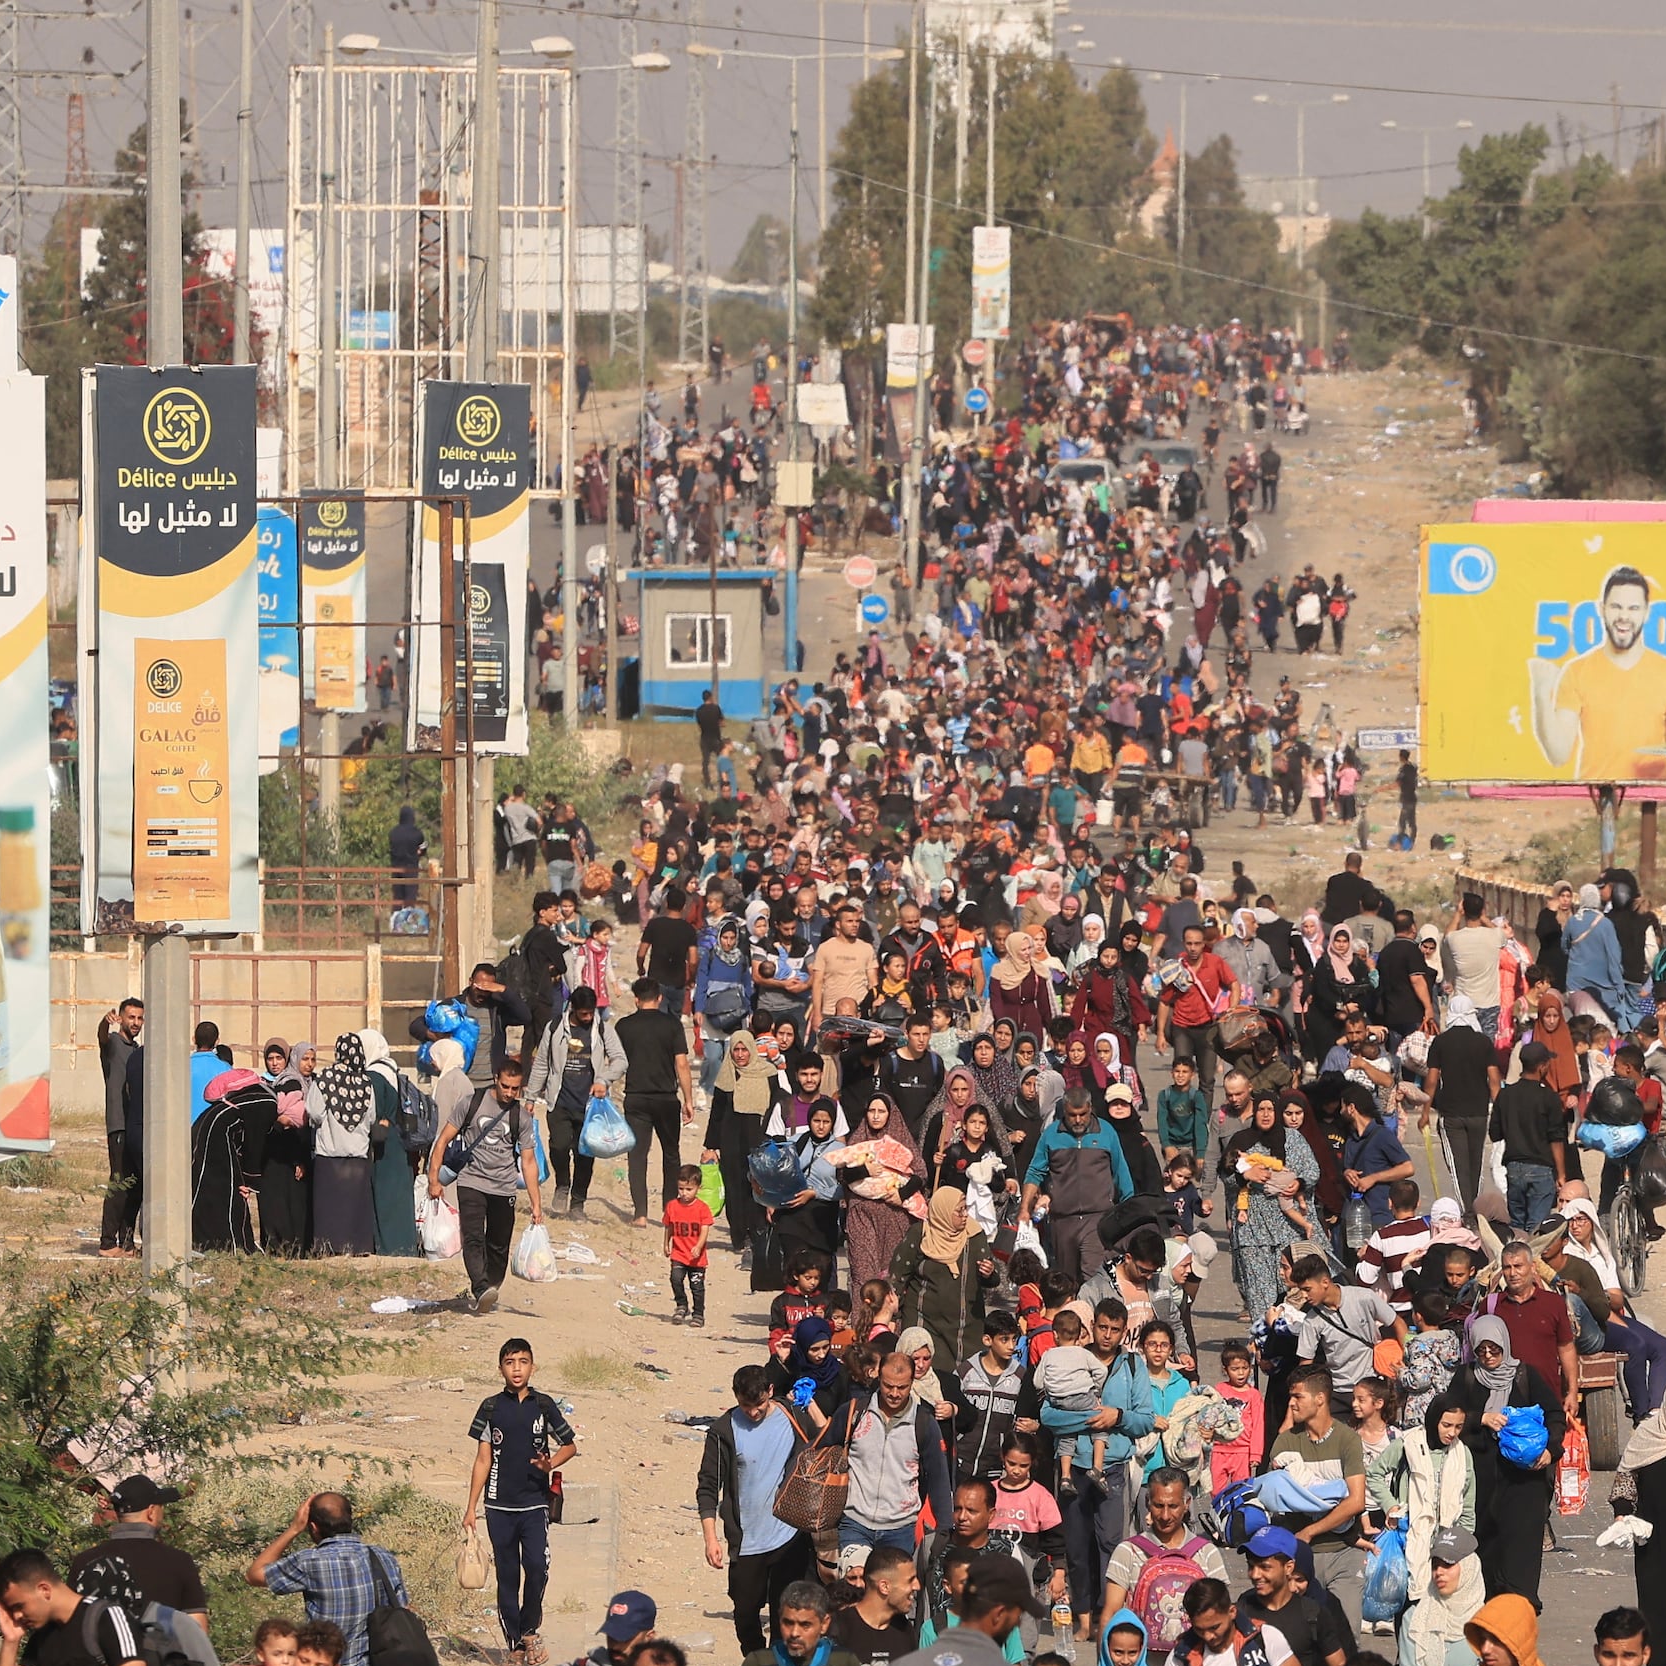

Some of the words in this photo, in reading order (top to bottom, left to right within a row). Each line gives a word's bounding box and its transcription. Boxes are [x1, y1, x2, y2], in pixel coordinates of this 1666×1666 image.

[439, 446, 477, 461] Délice
[480, 447, 517, 463] ديليس
[117, 466, 176, 488] Délice
[182, 467, 237, 491] ديليس
[438, 468, 460, 489] لها
[463, 467, 499, 491] مثيل
[503, 470, 516, 487] لا
[118, 502, 150, 534] لها
[158, 499, 212, 534] مثيل
[218, 502, 237, 527] لا
[307, 540, 322, 554] لها
[324, 539, 347, 555] مثيل
[349, 540, 359, 552] لا
[147, 701, 182, 713] DELICE
[139, 728, 197, 743] GALAG
[166, 745, 197, 753] COFFEE
